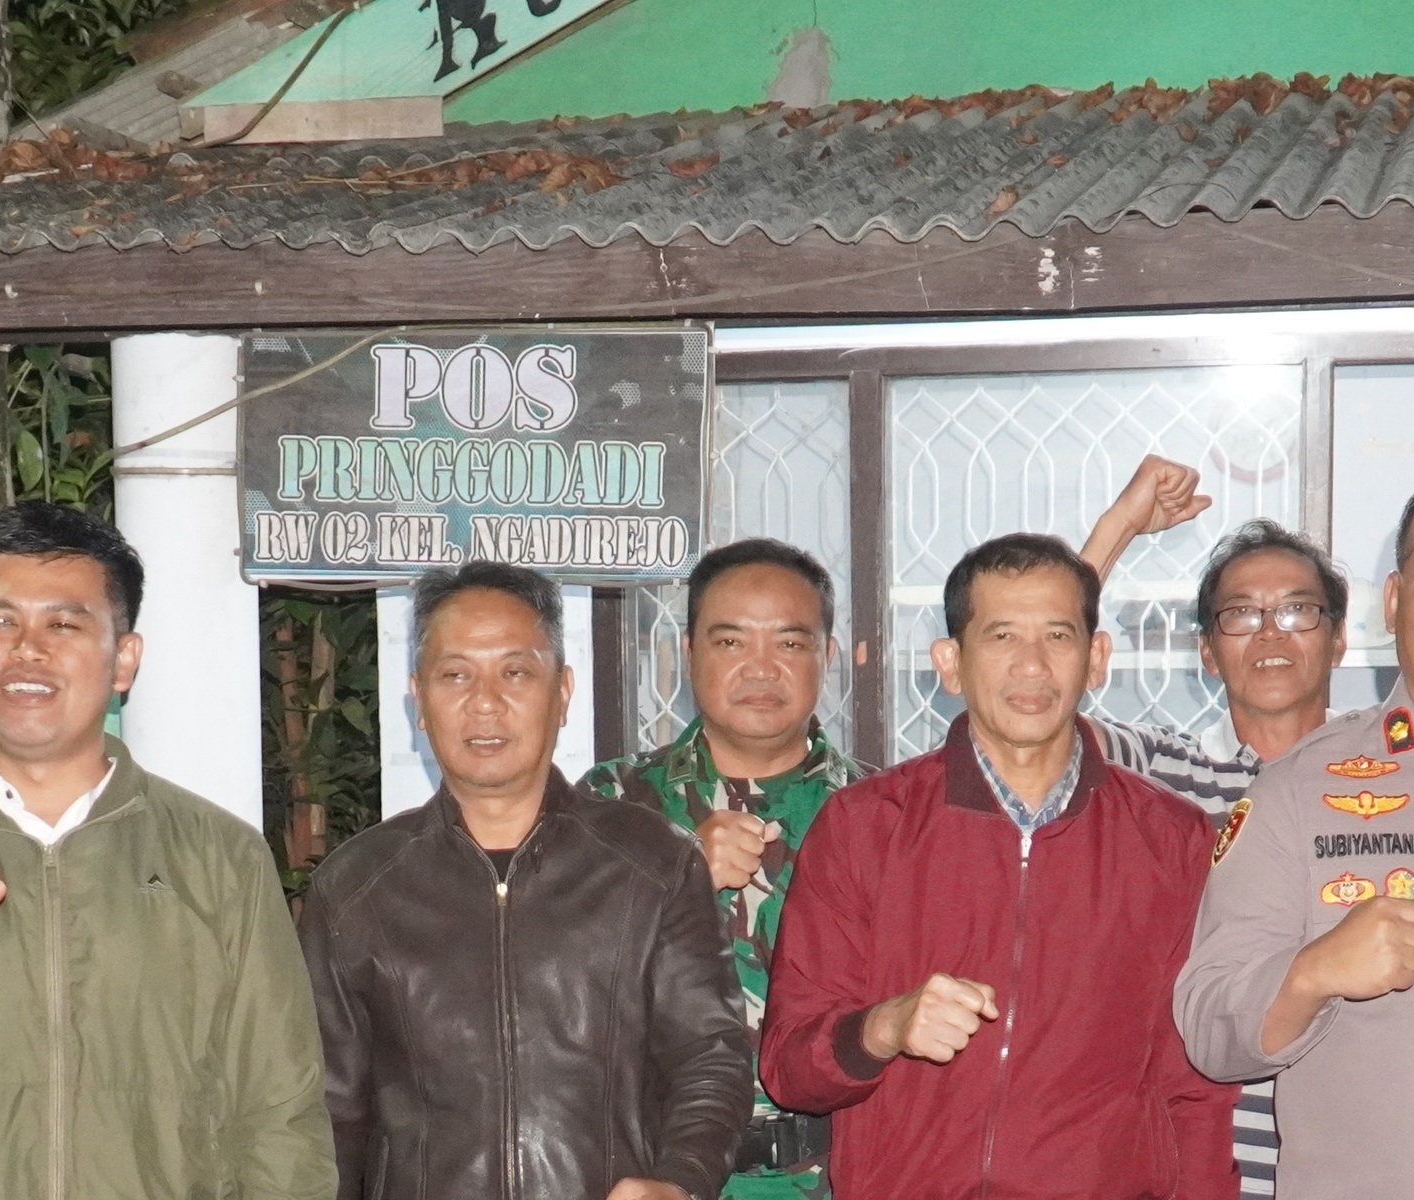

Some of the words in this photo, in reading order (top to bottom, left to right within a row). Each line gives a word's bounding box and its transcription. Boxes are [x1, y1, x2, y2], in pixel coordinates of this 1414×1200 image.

[370, 343, 578, 432] POS
[279, 436, 666, 508] PRINGGODADI
[255, 511, 318, 562] RW
[321, 512, 373, 563] 02
[376, 513, 463, 565] KEL.
[471, 515, 689, 568] NGADIREJO
